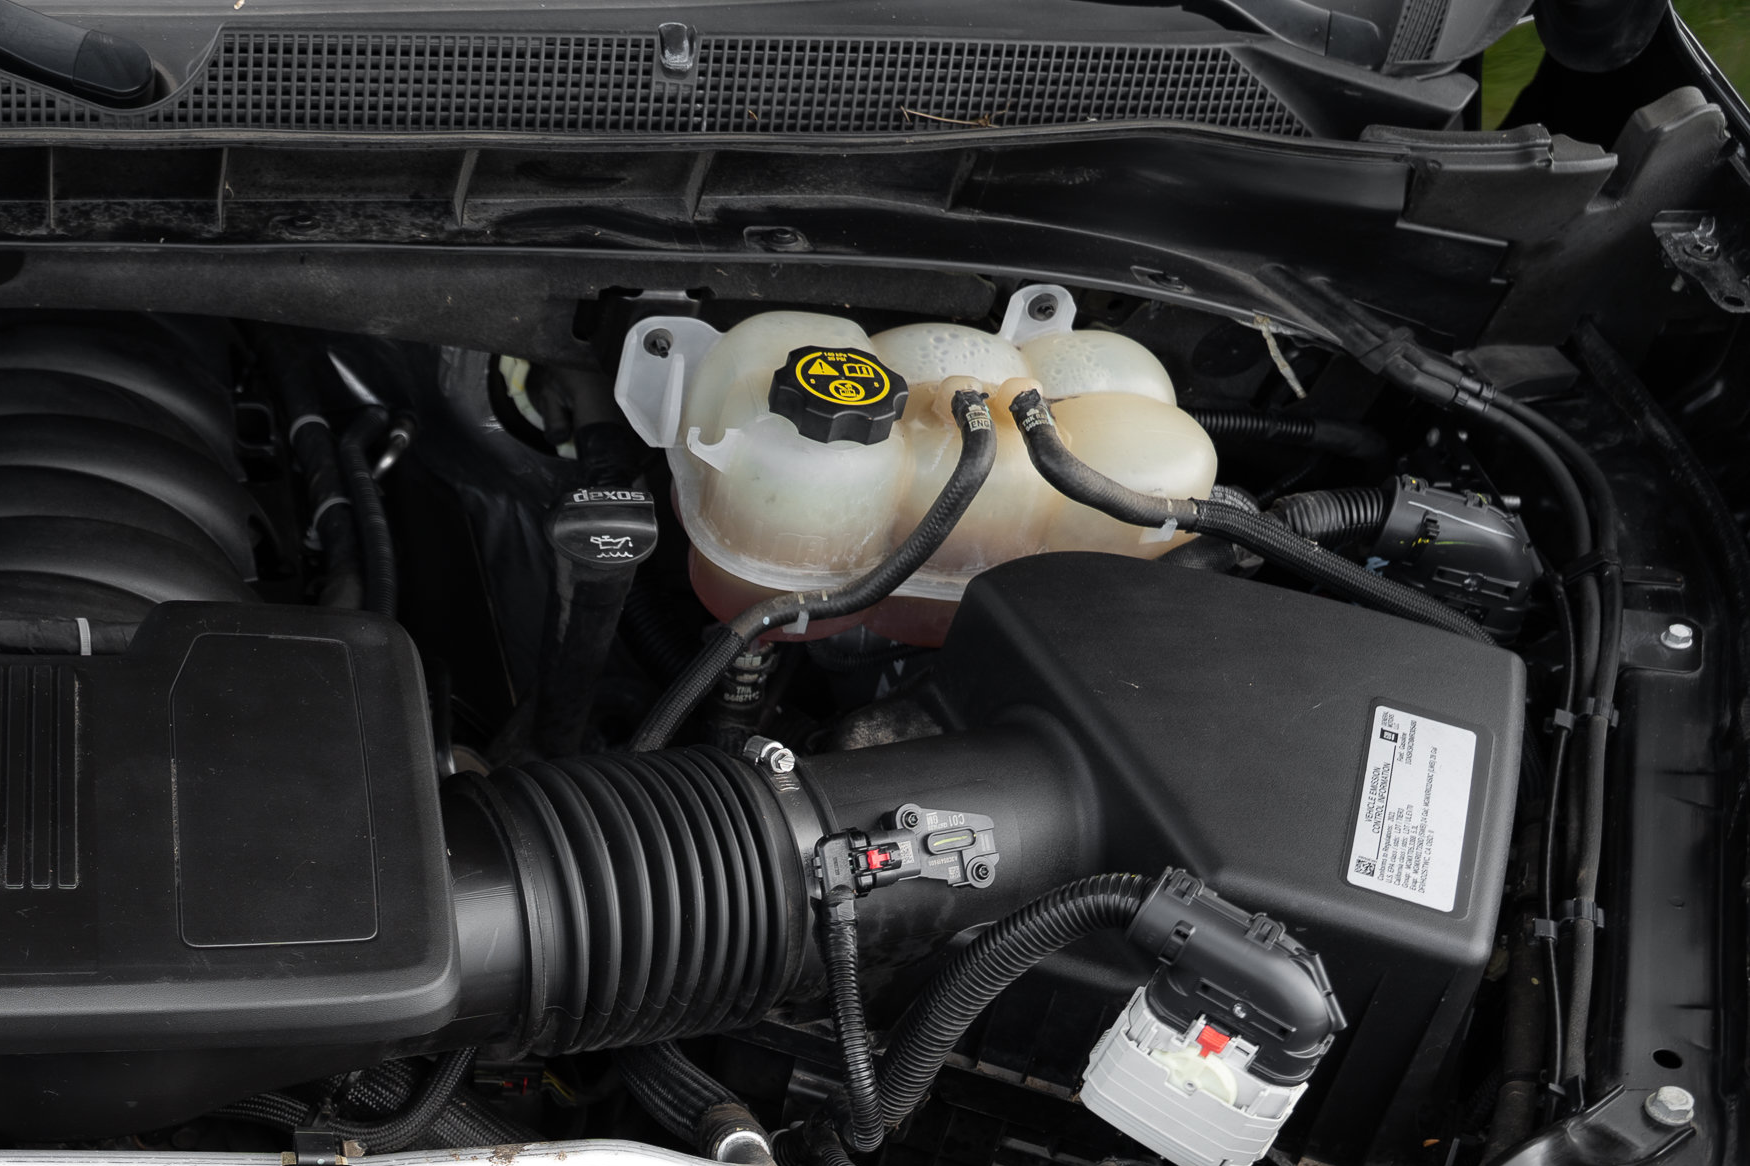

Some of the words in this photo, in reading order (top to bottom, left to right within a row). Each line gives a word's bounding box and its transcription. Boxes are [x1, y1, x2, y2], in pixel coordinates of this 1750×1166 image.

[572, 489, 646, 503] dexos
[1365, 795, 1375, 822] VEHICLE
[1370, 766, 1380, 795] EMISSION
[1378, 761, 1390, 803] INFORMATION
[1373, 803, 1384, 834] CONTROL
